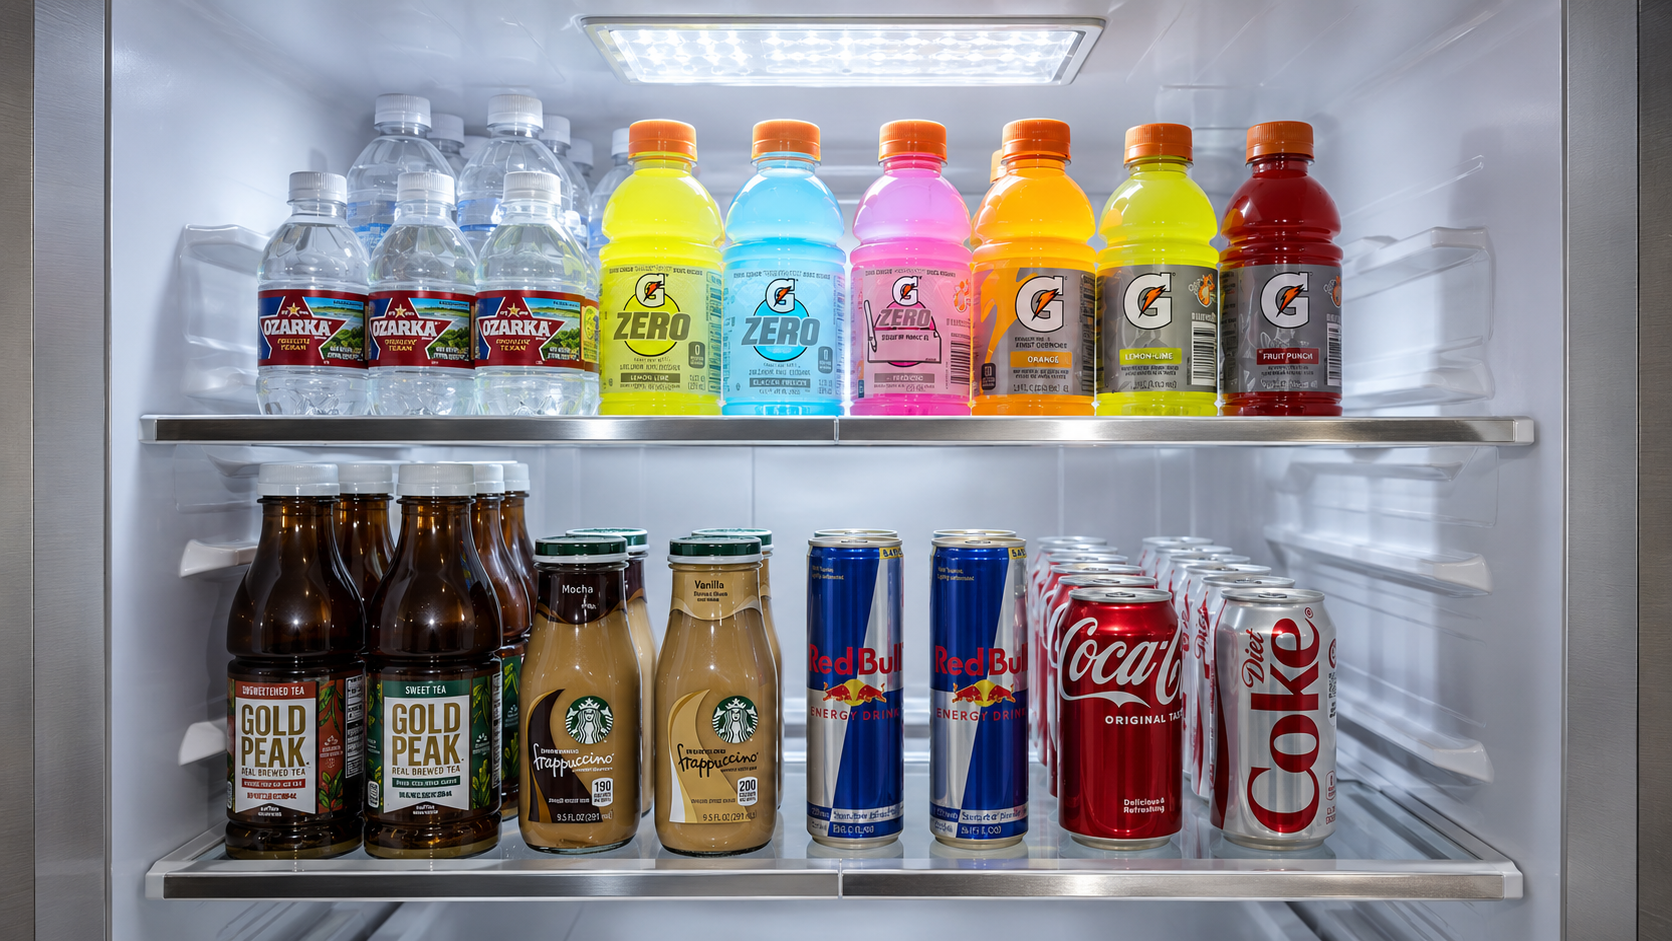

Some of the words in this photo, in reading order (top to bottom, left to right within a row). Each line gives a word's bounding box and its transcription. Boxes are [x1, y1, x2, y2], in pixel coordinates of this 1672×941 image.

[878, 308, 932, 326] ZERO
[264, 320, 331, 336] OZARKA
[373, 320, 437, 337] OZARKA
[483, 319, 551, 337] OZARKA
[613, 312, 691, 340] ZERO
[741, 317, 820, 346] ZERO
[1027, 355, 1059, 364] ORANGE
[1263, 352, 1284, 360] FRUIT
[1287, 352, 1313, 360] PUNCH
[562, 584, 593, 594] Mocha
[694, 580, 724, 589] Vanilla
[809, 643, 853, 675] Red
[858, 642, 902, 675] Bull
[935, 645, 983, 676] Red
[1240, 627, 1265, 688] Diet
[291, 686, 305, 695] TEA
[405, 686, 429, 695] SWEET
[432, 685, 446, 694] TEA
[241, 704, 306, 736] GOLD
[392, 702, 461, 735] GOLD
[810, 706, 857, 721] ENERGY
[863, 708, 899, 721] DRINK
[936, 708, 988, 721] ENERGY
[1105, 714, 1166, 725] ORIGINAL
[1247, 616, 1320, 834] Coke
[533, 743, 613, 778] frappuccino
[677, 743, 757, 778] frappuccino
[242, 767, 255, 777] REAL
[258, 768, 288, 777] BREWED
[291, 768, 306, 776] TEA
[392, 767, 409, 775] REAL
[412, 767, 444, 776] BREWED
[447, 765, 460, 773] TEA
[594, 780, 611, 792] 190
[739, 779, 756, 792] 200
[1123, 798, 1159, 806] Delicious
[1123, 806, 1165, 814] Refreshing
